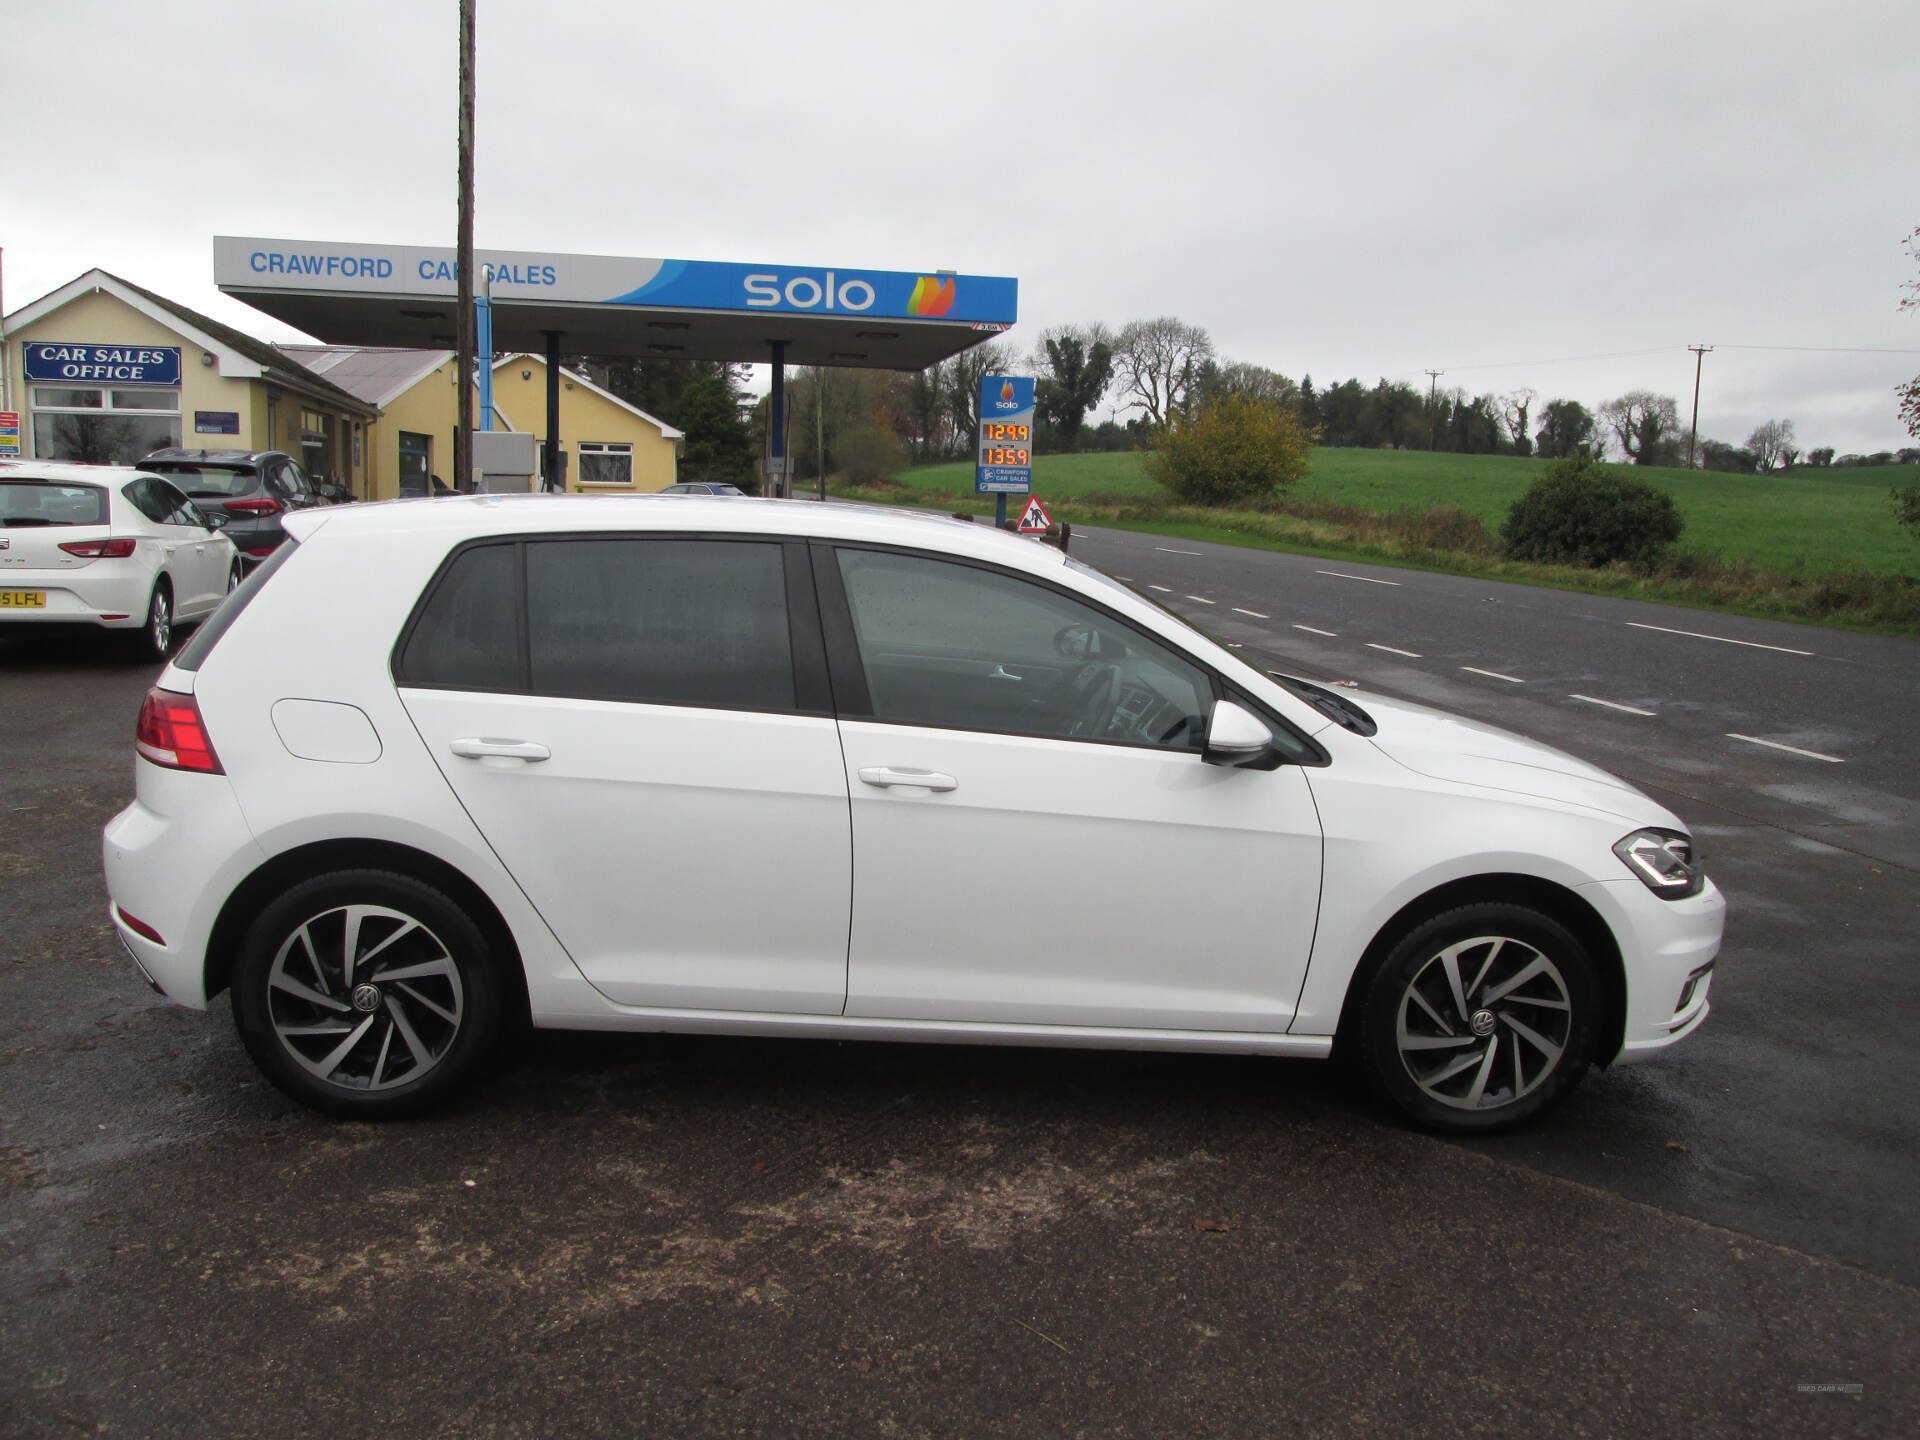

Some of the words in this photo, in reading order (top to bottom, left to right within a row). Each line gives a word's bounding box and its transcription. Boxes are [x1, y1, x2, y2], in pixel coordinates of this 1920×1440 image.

[250, 252, 393, 278] CRAWFORD
[418, 260, 459, 281] CA
[743, 271, 876, 311] solo
[40, 347, 87, 362] CAR
[94, 349, 165, 364] SALES
[62, 364, 144, 380] OFFICE
[995, 401, 1019, 409] solo
[988, 424, 1029, 440] 129.9
[988, 448, 1028, 465] 135.9
[0, 593, 11, 605] 5
[15, 593, 43, 605] LFL
